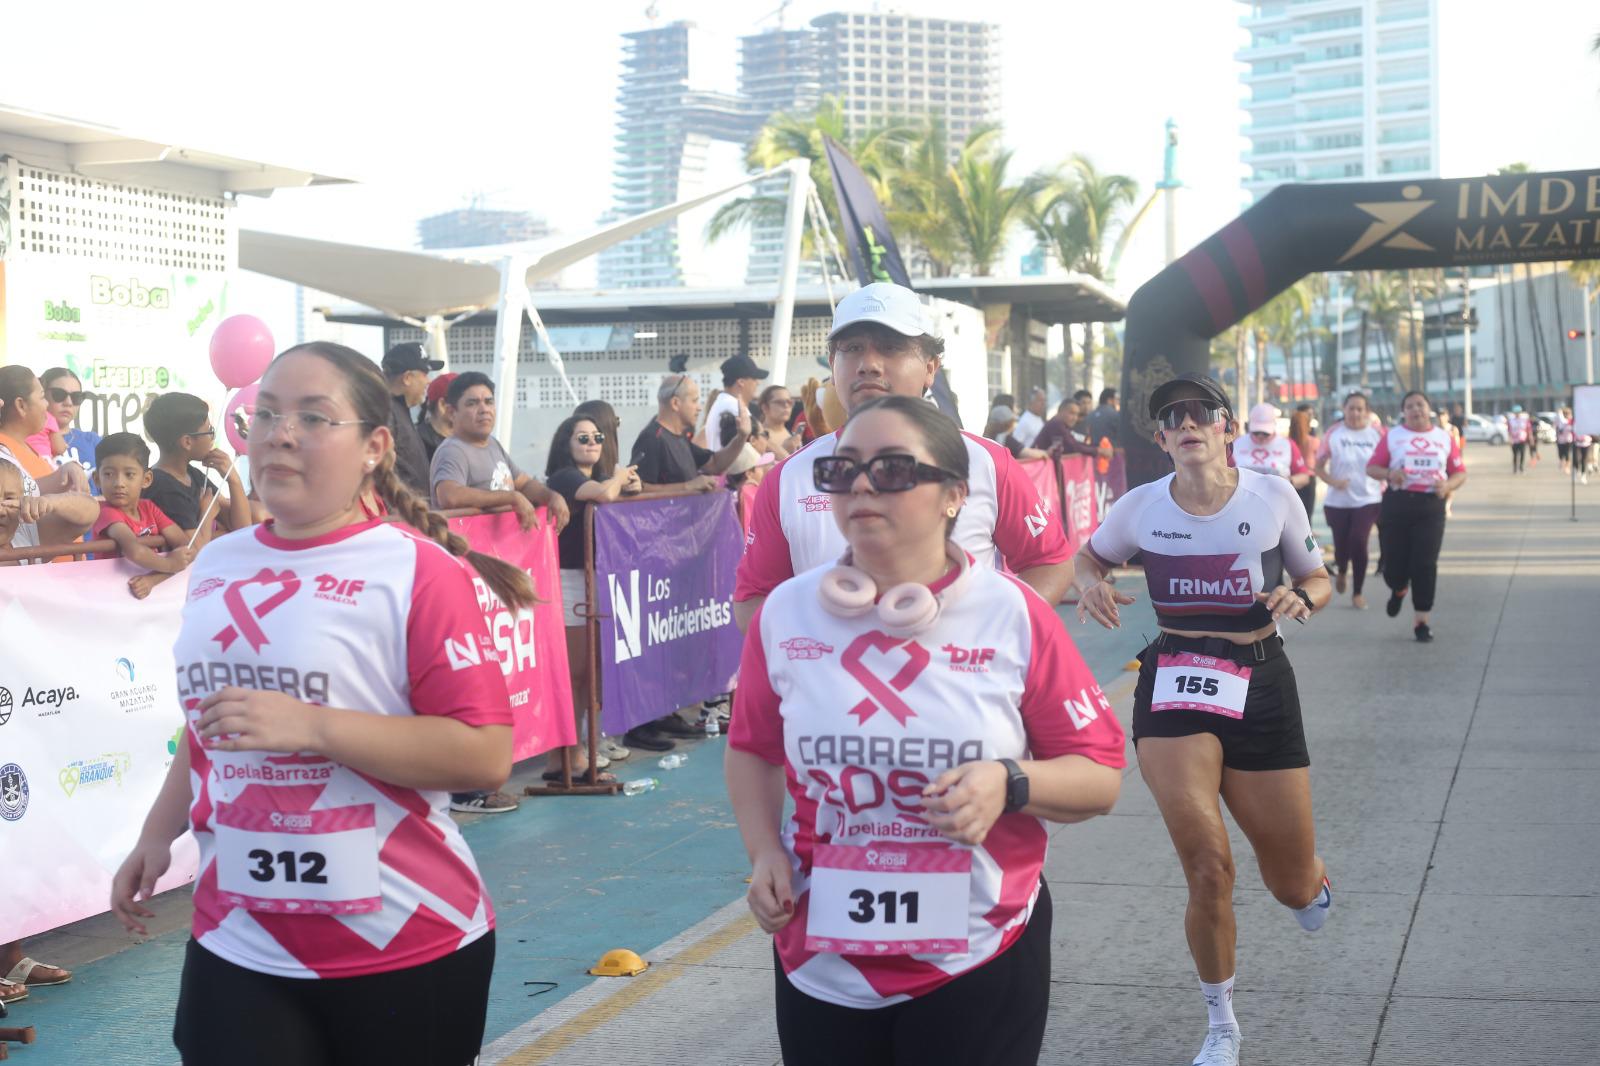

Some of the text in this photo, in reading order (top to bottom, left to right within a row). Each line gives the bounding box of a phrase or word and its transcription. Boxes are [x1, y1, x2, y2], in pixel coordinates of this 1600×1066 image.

[90, 275, 169, 309] Boba
[44, 300, 81, 323] Boba
[314, 573, 365, 598] DIF
[647, 574, 671, 603] Los
[1169, 577, 1251, 597] TRIMAZ
[647, 597, 732, 647] Noticieristas
[942, 643, 996, 665] DIF
[1175, 675, 1219, 696] 155
[798, 735, 984, 768] CARRERA
[848, 823, 944, 839] DeliaBarra
[248, 849, 327, 884] 312
[848, 889, 919, 924] 311
